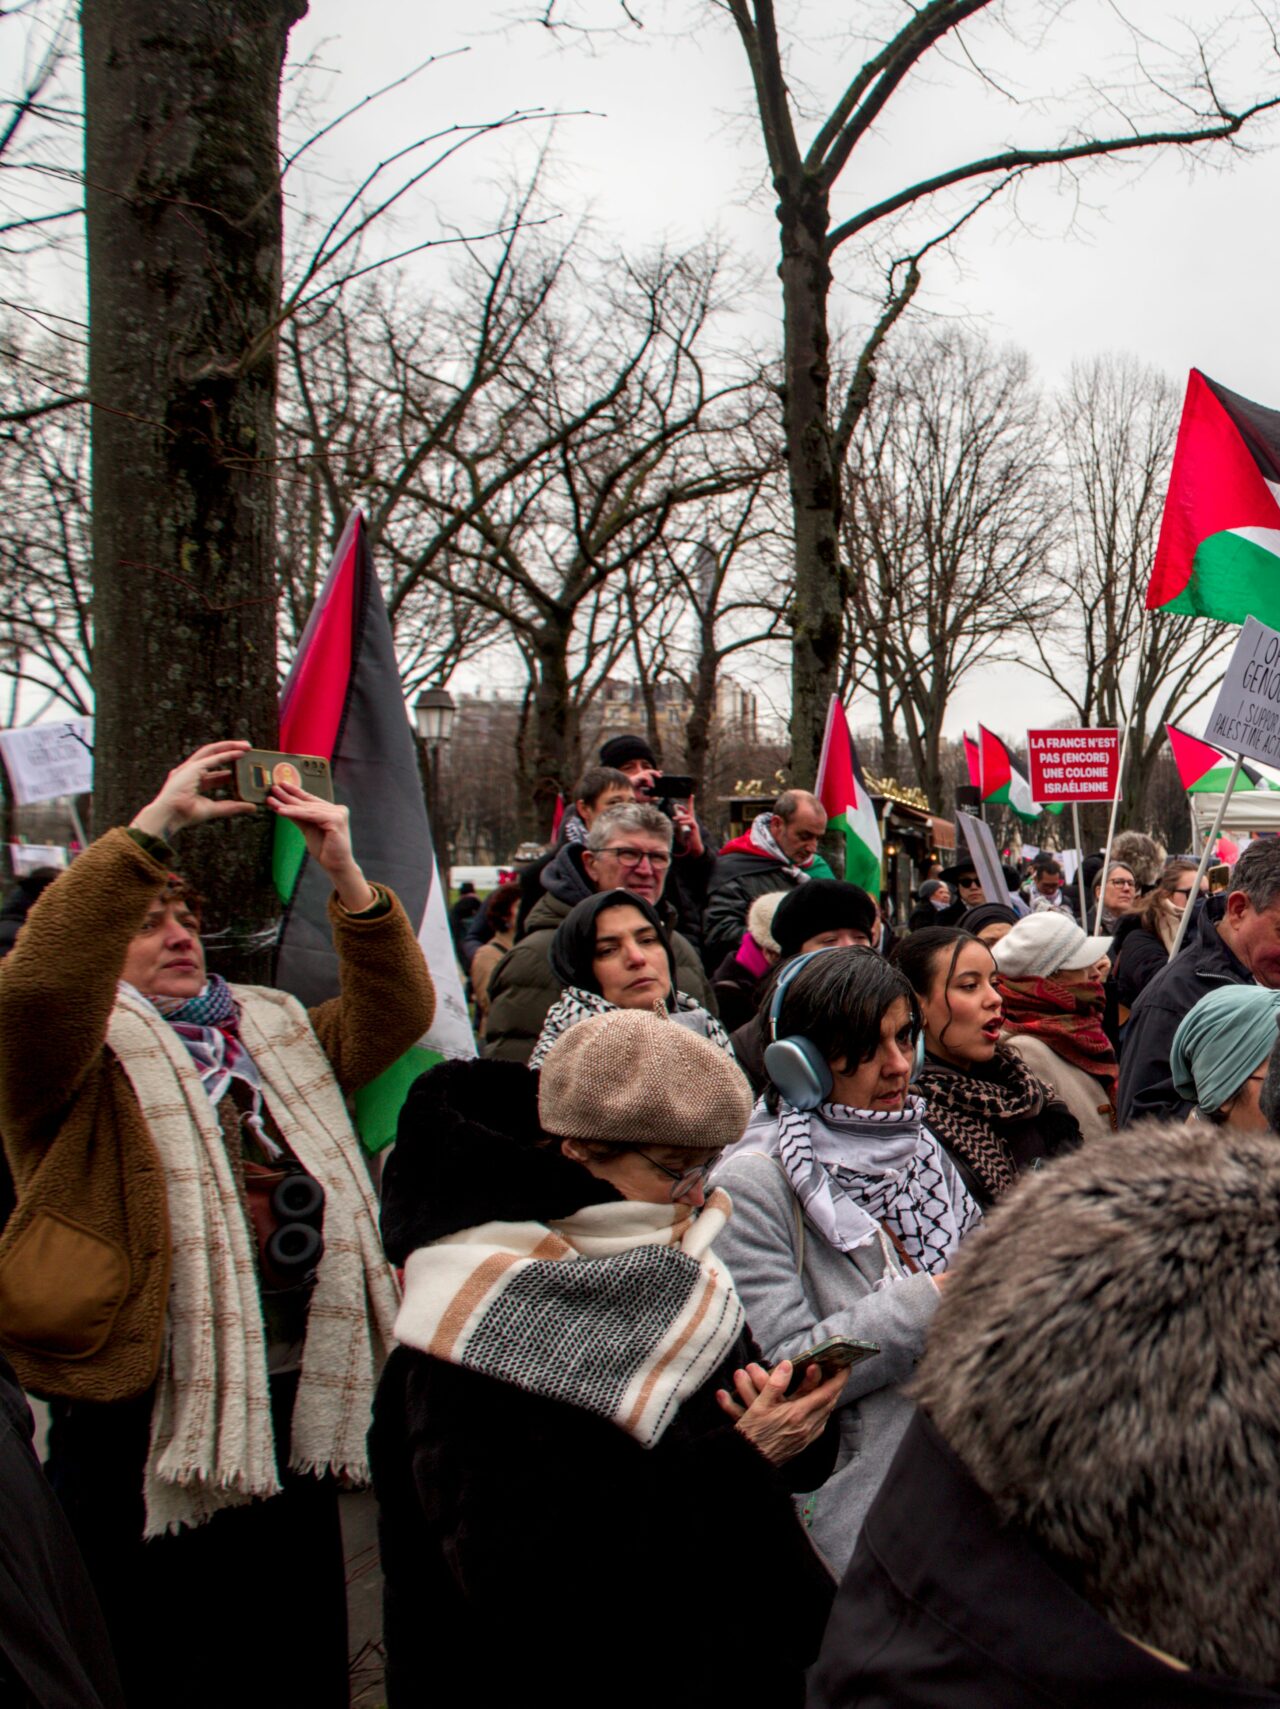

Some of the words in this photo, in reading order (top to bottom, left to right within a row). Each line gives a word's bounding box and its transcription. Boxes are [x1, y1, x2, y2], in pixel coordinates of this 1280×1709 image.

[1253, 631, 1264, 658] I
[1237, 700, 1245, 718] I
[1213, 713, 1264, 749] PALESTINE
[1031, 738, 1046, 749] LA
[1046, 737, 1087, 749] FRANCE
[1088, 737, 1117, 748] N'EST
[1039, 752, 1060, 763] PAS
[1061, 752, 1110, 765] (ENCORE)
[1042, 767, 1064, 778] UNE
[1065, 767, 1109, 778] COLONIE
[1044, 779, 1109, 793] ISRAÉLIENNE
